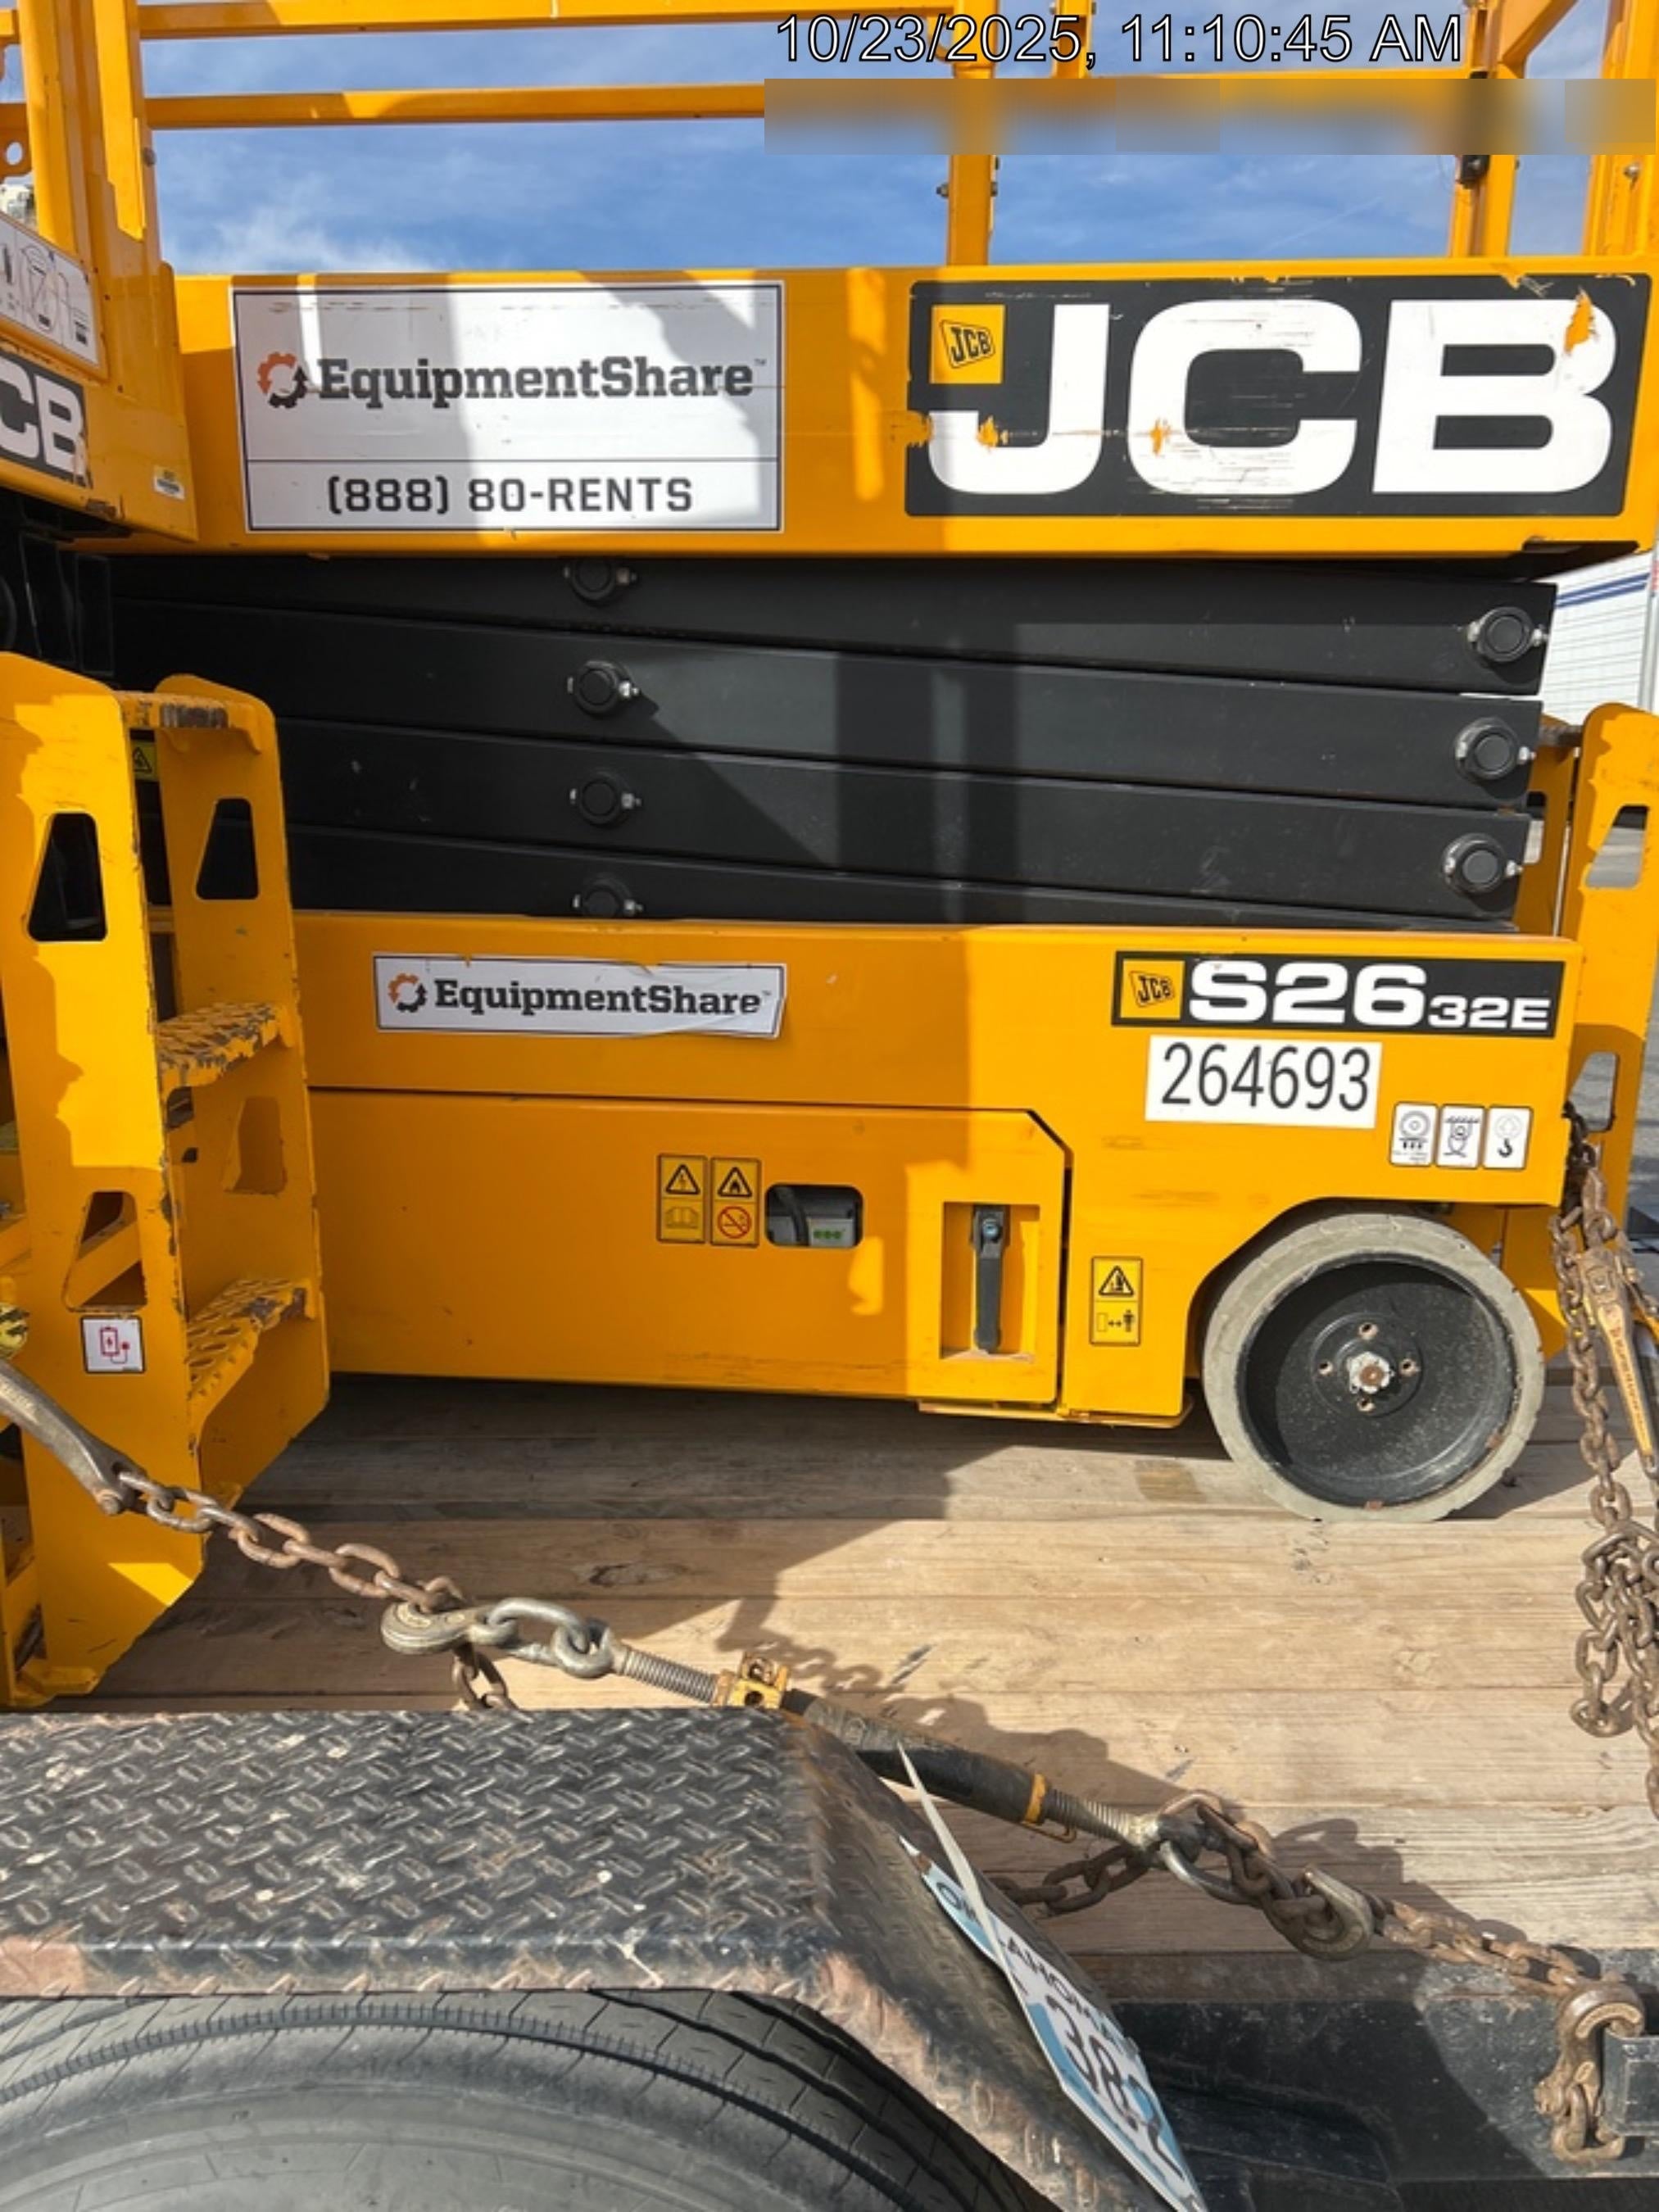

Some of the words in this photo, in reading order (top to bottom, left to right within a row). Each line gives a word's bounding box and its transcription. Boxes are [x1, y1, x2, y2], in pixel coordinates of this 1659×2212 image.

[950, 326, 991, 362] JCB
[927, 298, 1617, 496] JCB
[328, 475, 448, 514] (888)
[469, 477, 692, 514] 80-RENTS
[1138, 974, 1172, 1003] JCB
[1162, 1041, 1371, 1113] 264693
